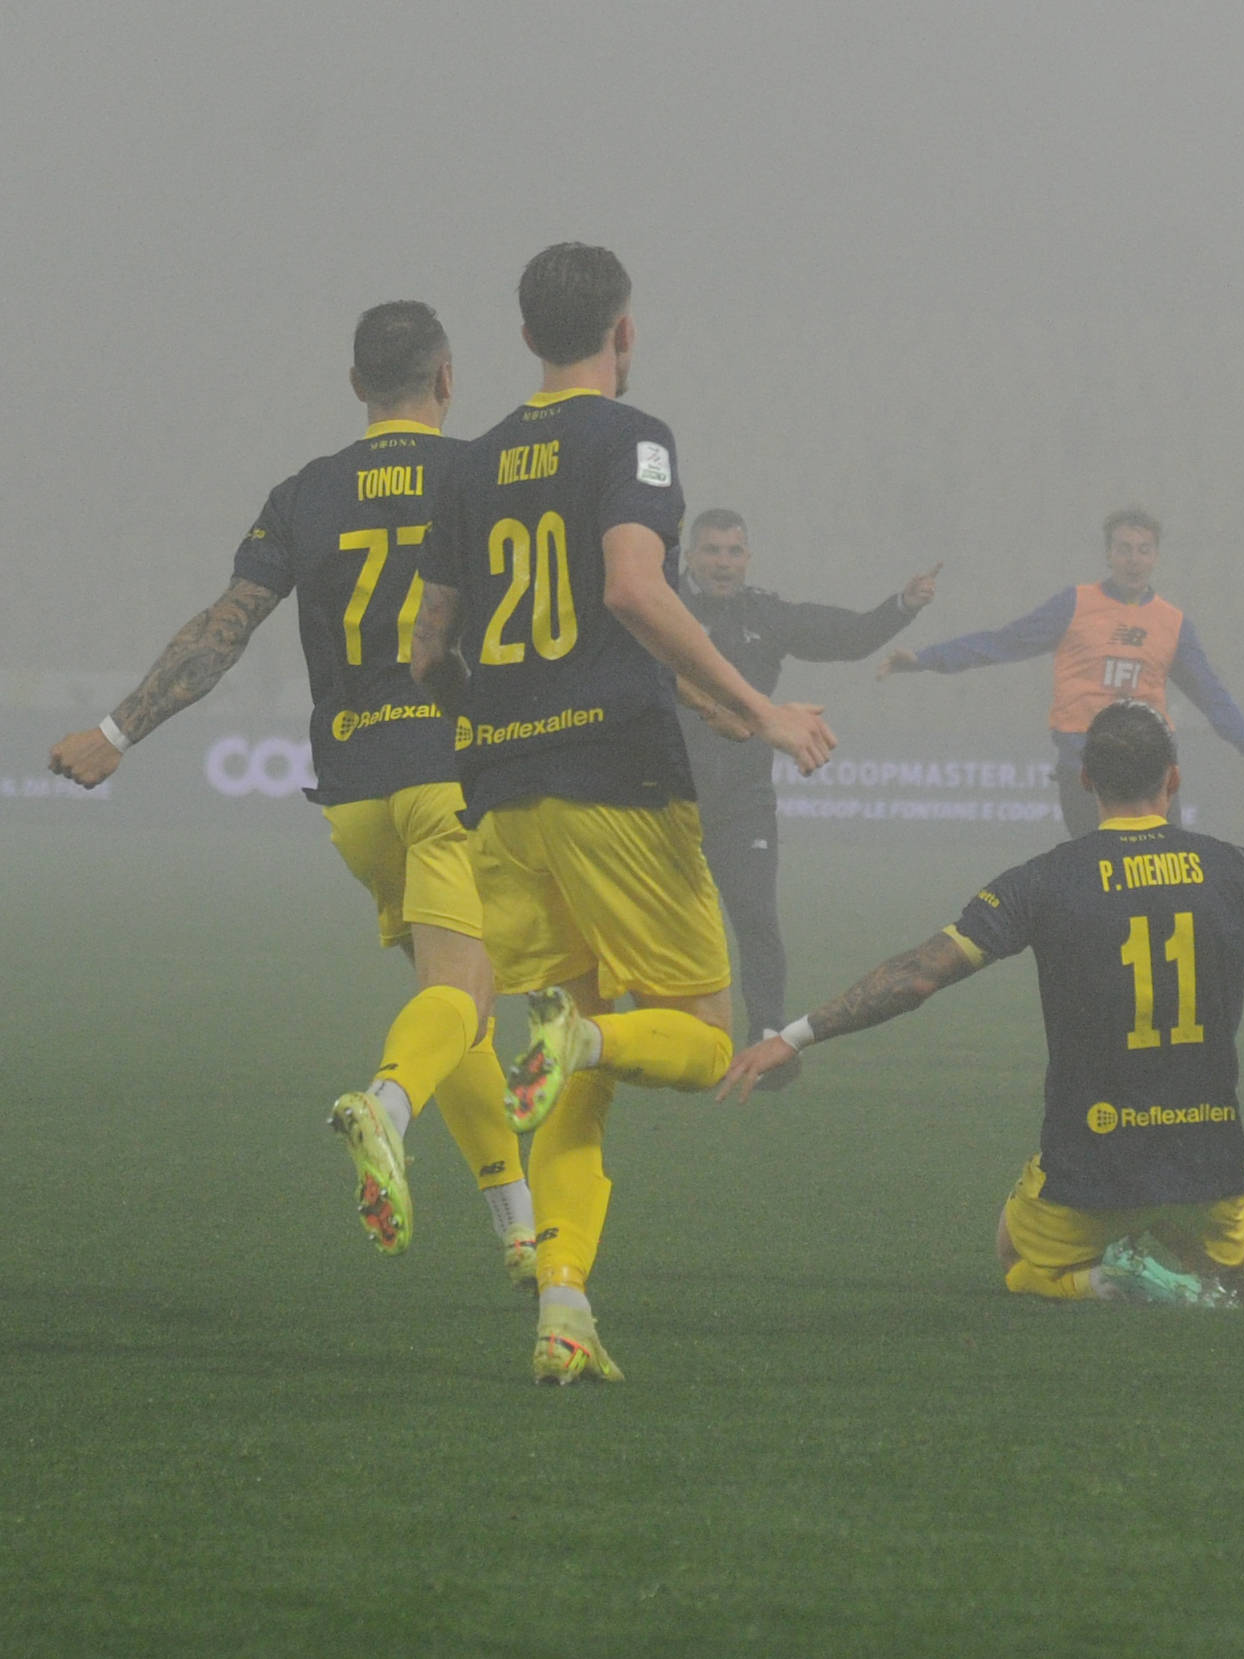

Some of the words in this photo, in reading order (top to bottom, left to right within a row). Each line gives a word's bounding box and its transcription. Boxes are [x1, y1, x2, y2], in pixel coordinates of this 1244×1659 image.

[497, 440, 560, 485] NIELING
[357, 465, 424, 501] TONOLI
[339, 521, 433, 665] 77
[479, 510, 578, 666] 20
[1104, 660, 1142, 689] IFI
[358, 703, 442, 729] Reflexal
[477, 706, 604, 746] Reflexallen
[1100, 860, 1122, 891] P.
[1124, 852, 1204, 889] MENDES
[1120, 912, 1205, 1049] 11
[1121, 1103, 1236, 1127] Reflexallen
